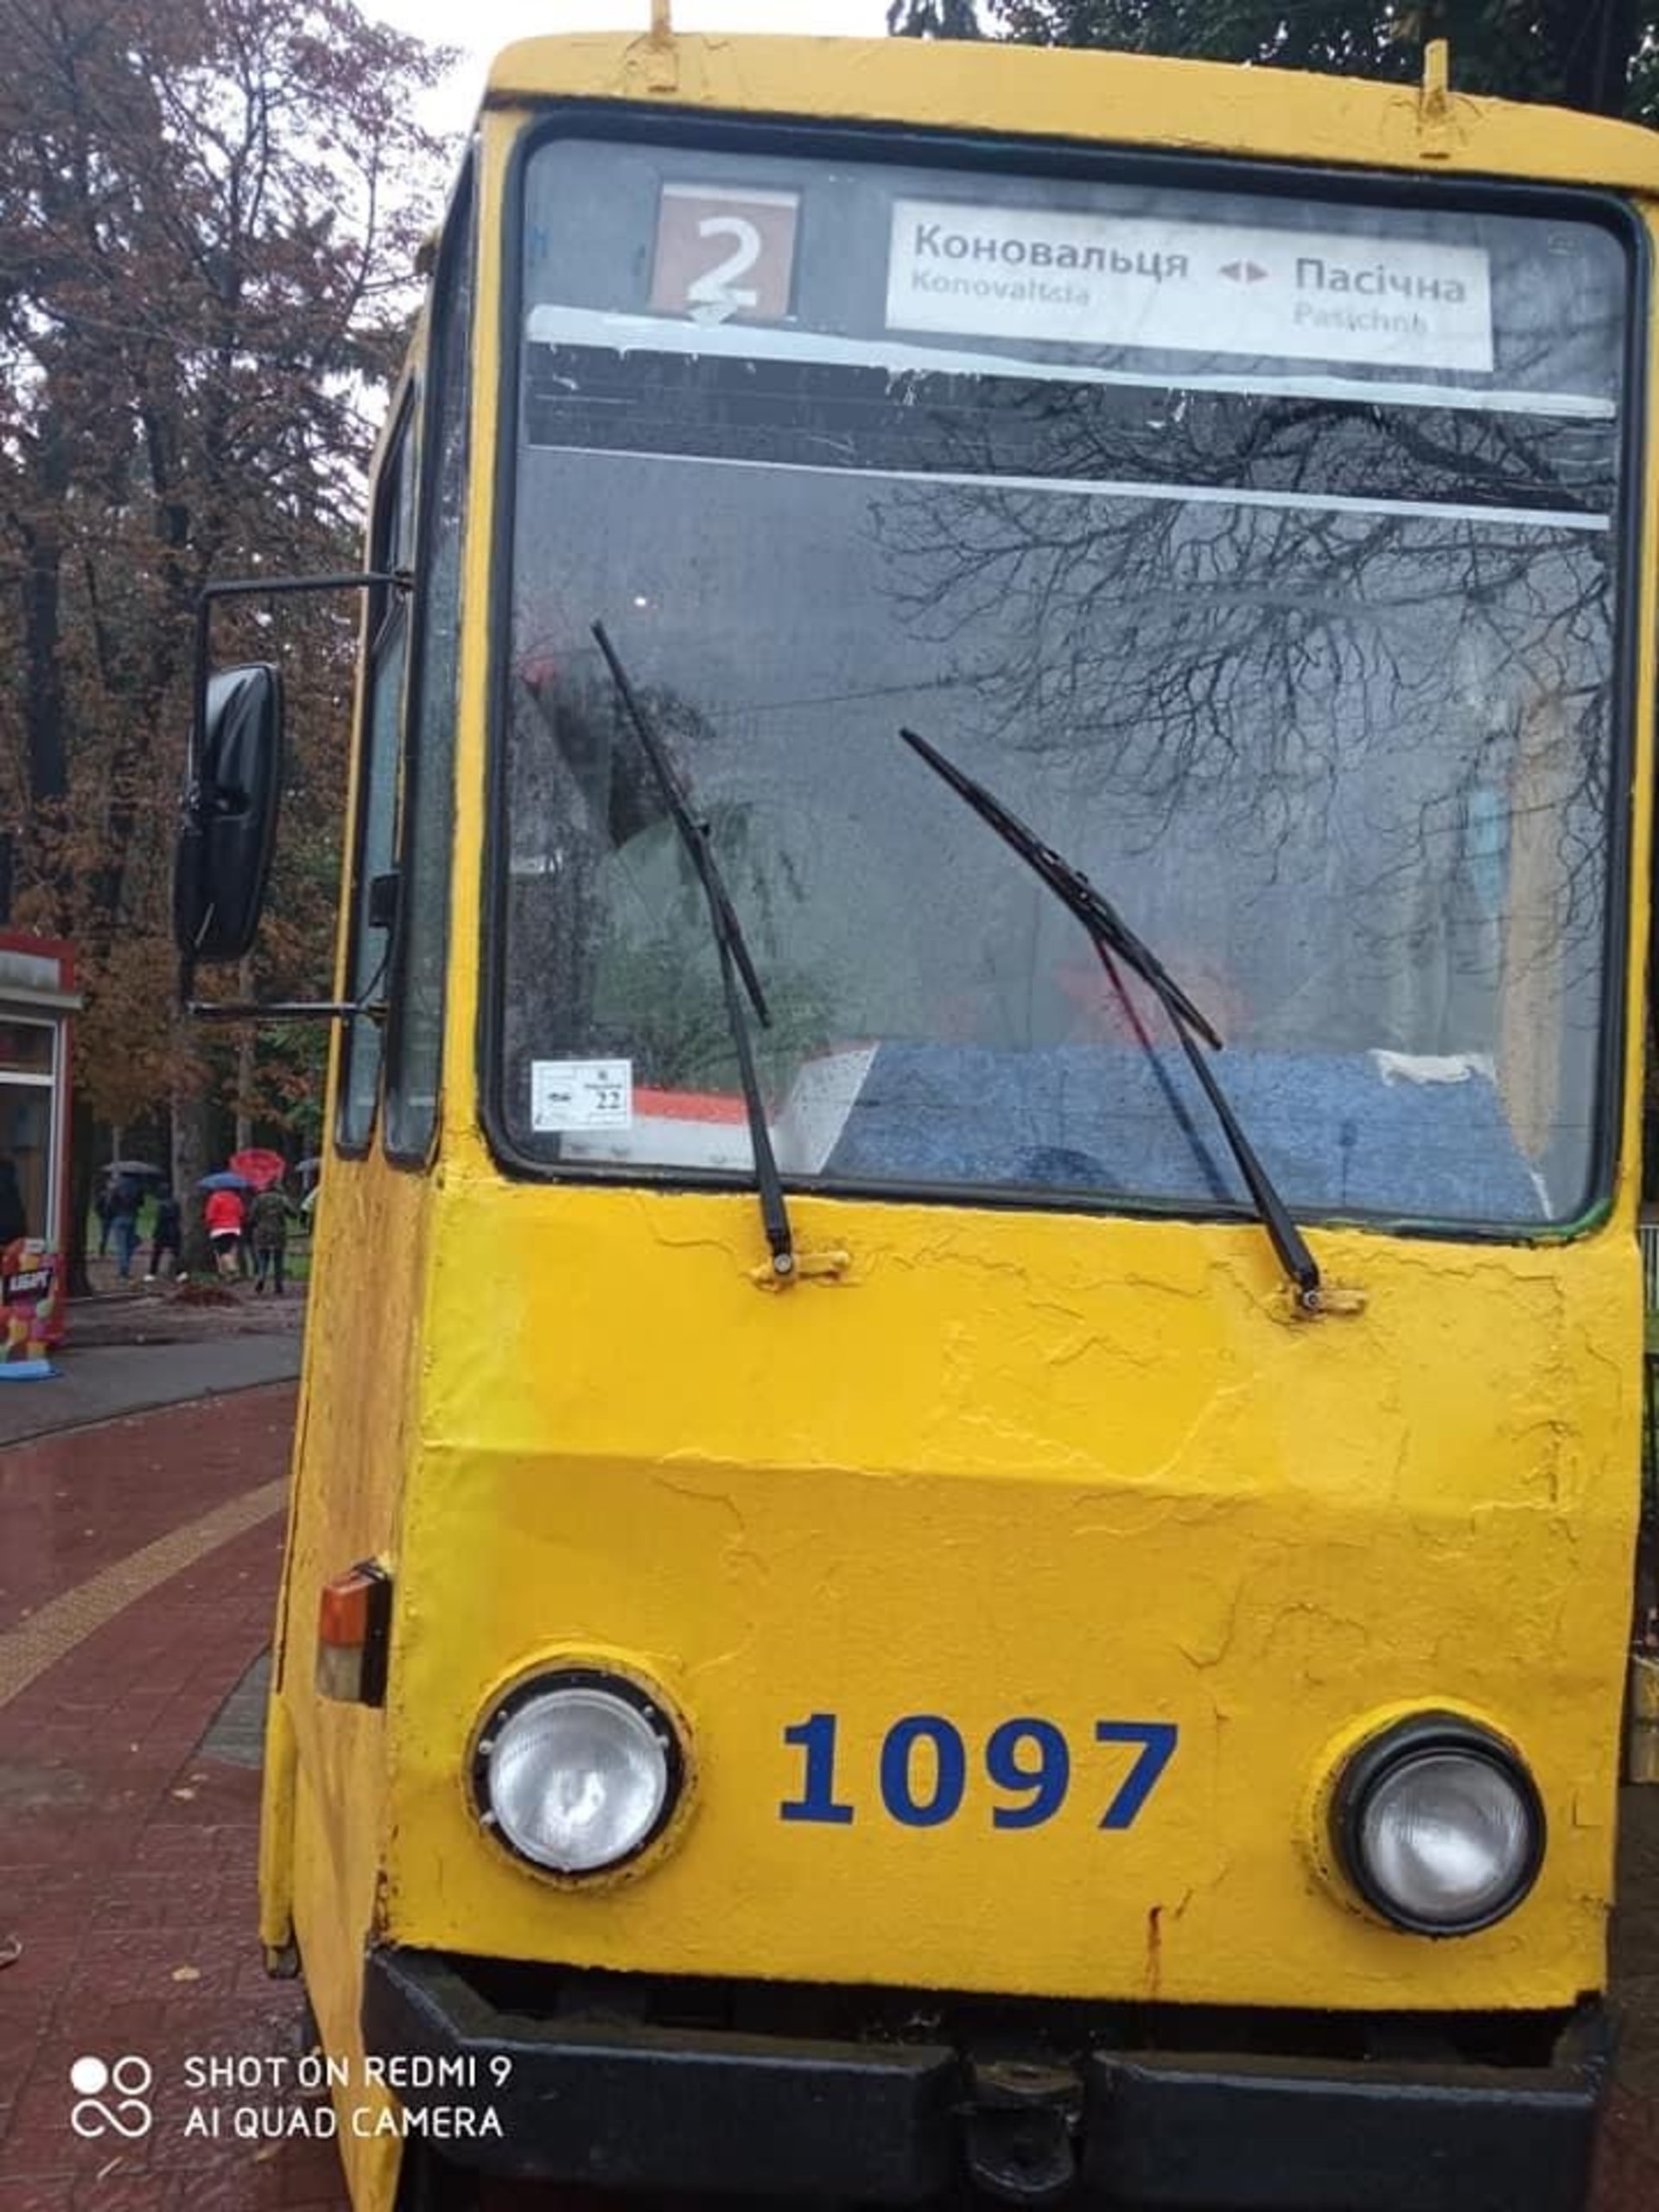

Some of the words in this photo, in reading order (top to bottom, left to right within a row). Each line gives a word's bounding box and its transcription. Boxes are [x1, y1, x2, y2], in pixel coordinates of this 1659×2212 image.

[688, 216, 761, 307] 2
[914, 223, 1190, 283] Коновальця
[1295, 257, 1466, 303] Пасічна
[779, 1713, 1179, 1830] 1097
